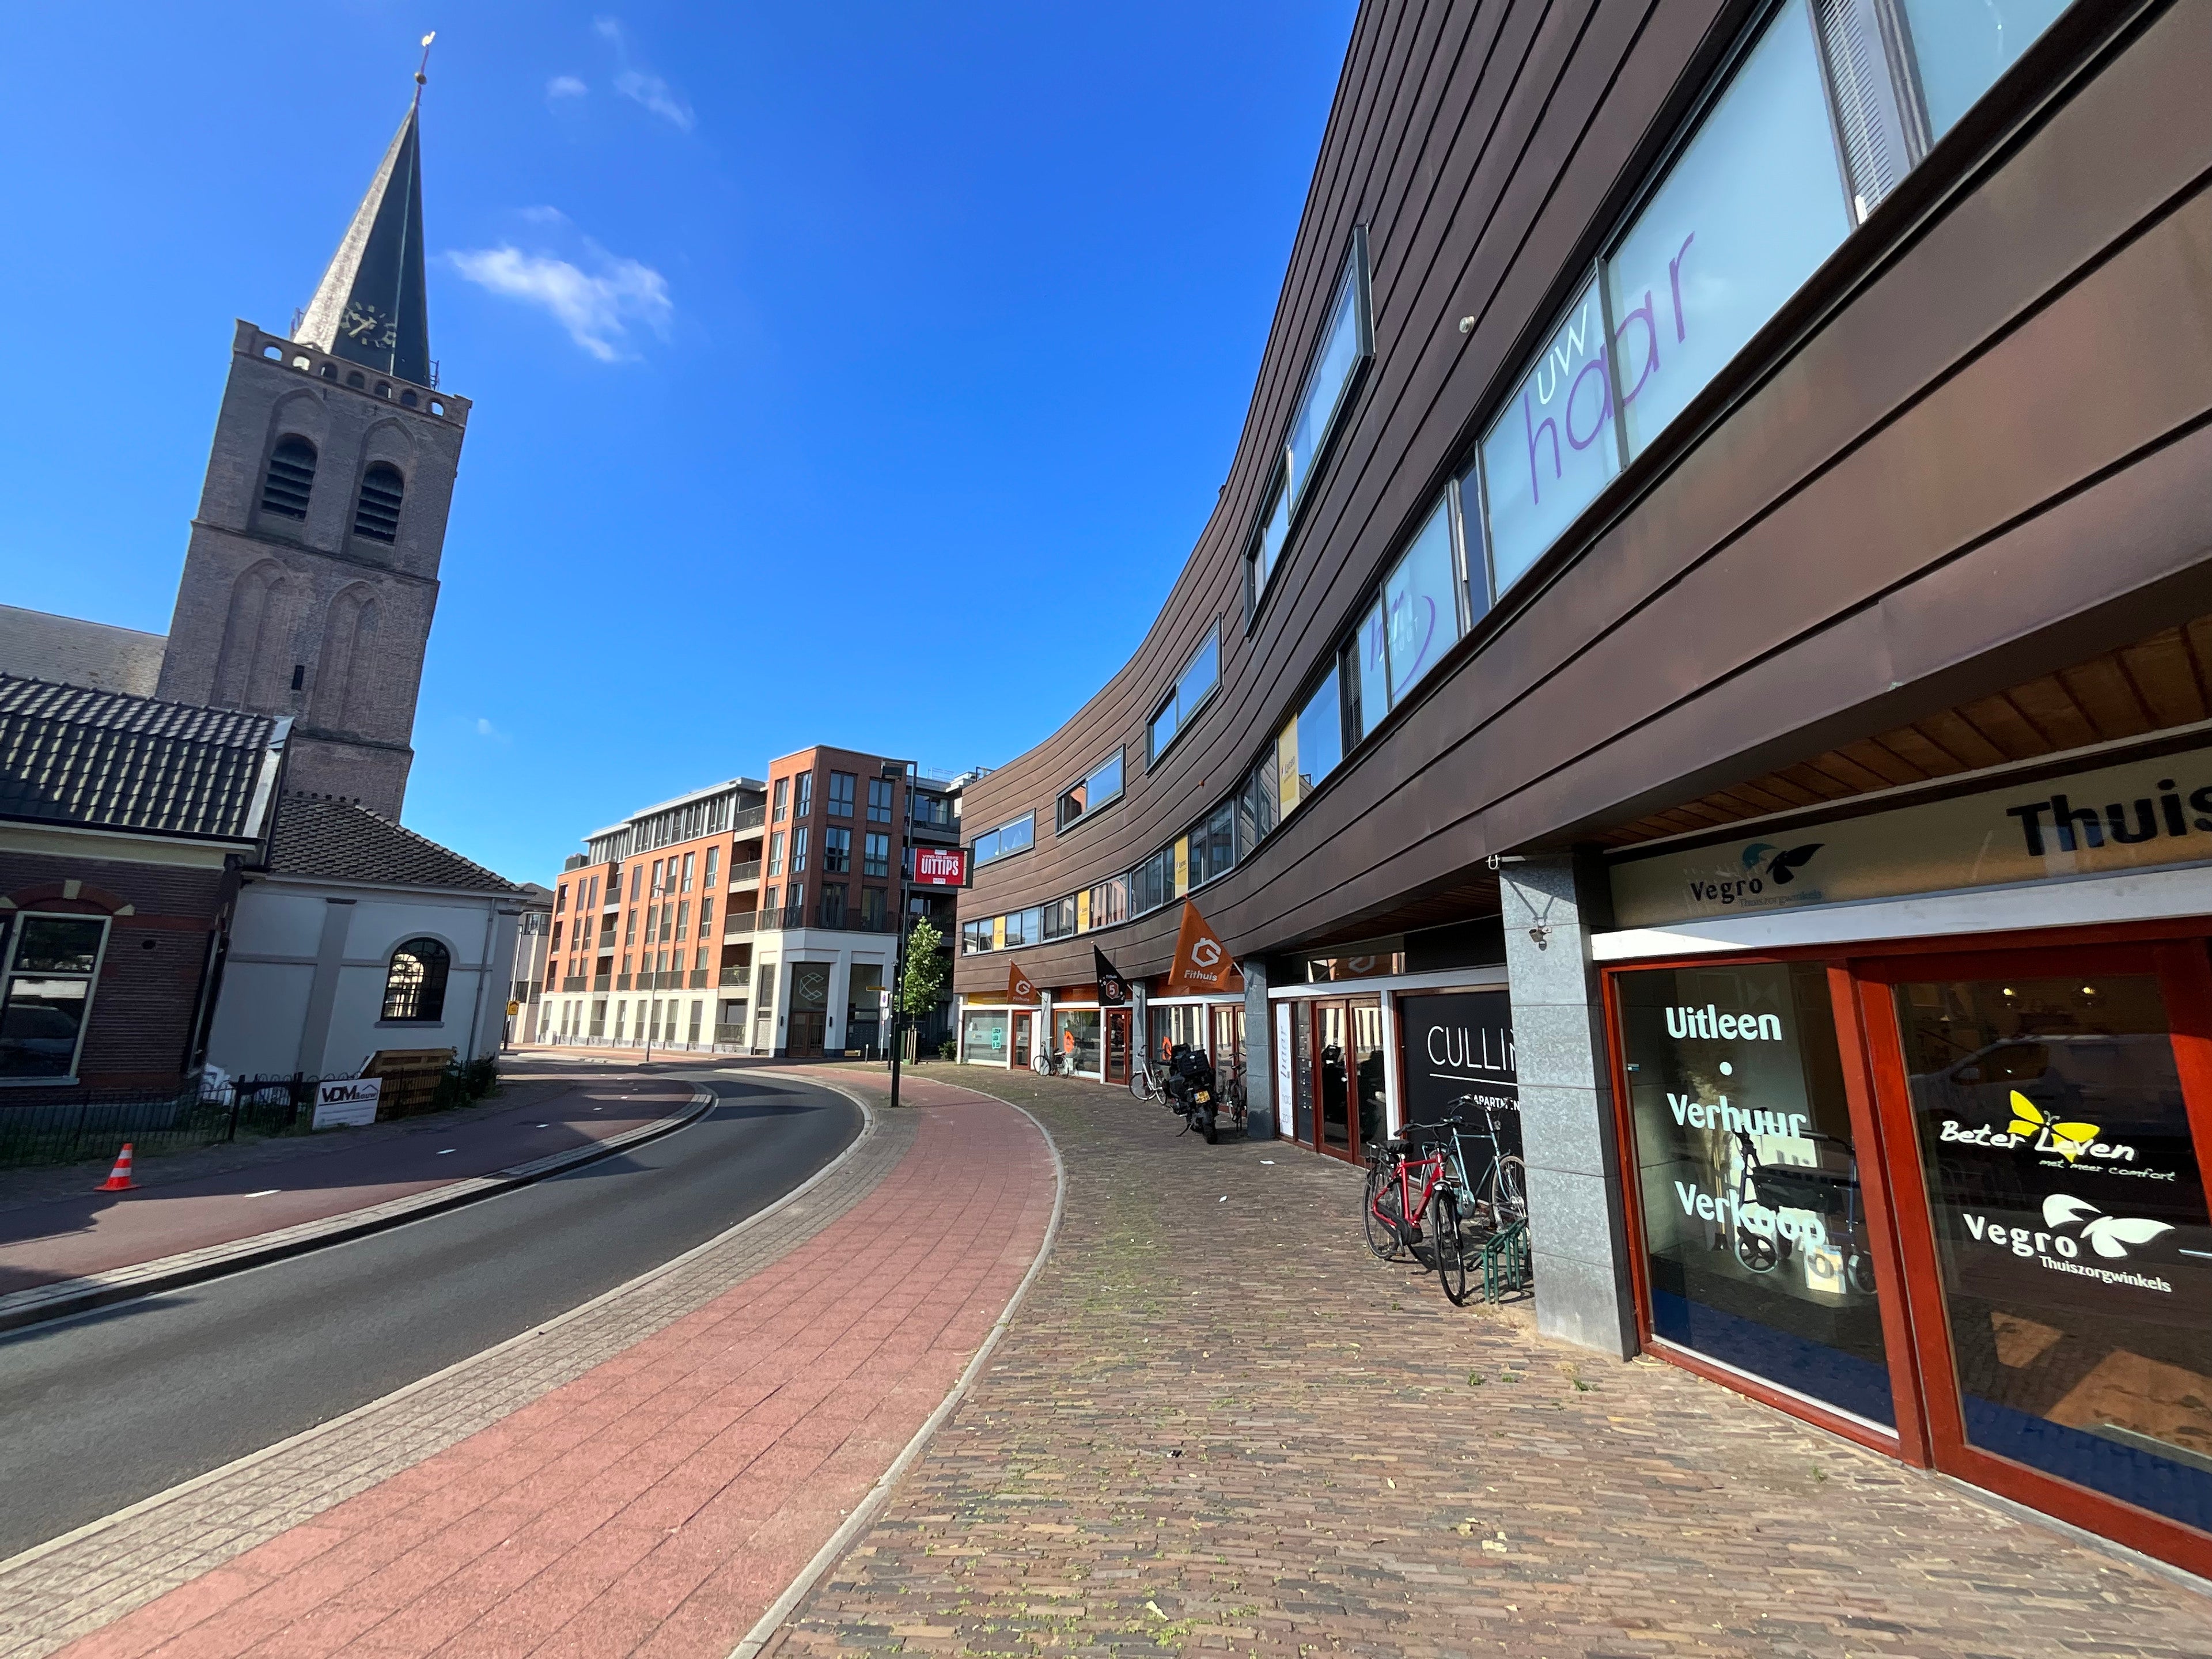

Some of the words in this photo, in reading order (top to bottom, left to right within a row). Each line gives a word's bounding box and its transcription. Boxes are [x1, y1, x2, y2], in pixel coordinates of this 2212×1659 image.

[1524, 230, 1696, 505] haar
[921, 858, 959, 876] UITTIPS
[1690, 877, 1763, 904] Vegro
[1109, 984, 1116, 995] 5
[1184, 970, 1218, 982] Fithuis
[1665, 1004, 1782, 1041] Uitleen
[321, 1085, 358, 1103] VDM
[1666, 1093, 1806, 1138] Verhuur
[1940, 1120, 2027, 1149] Beter
[2034, 1127, 2135, 1161] Leven
[2039, 1159, 2065, 1169] met
[2070, 1163, 2103, 1172] meer
[1674, 1180, 1826, 1251] Verkoop
[1963, 1213, 2078, 1258] Vegro
[2039, 1255, 2172, 1293] Thuiszorgwinkels
